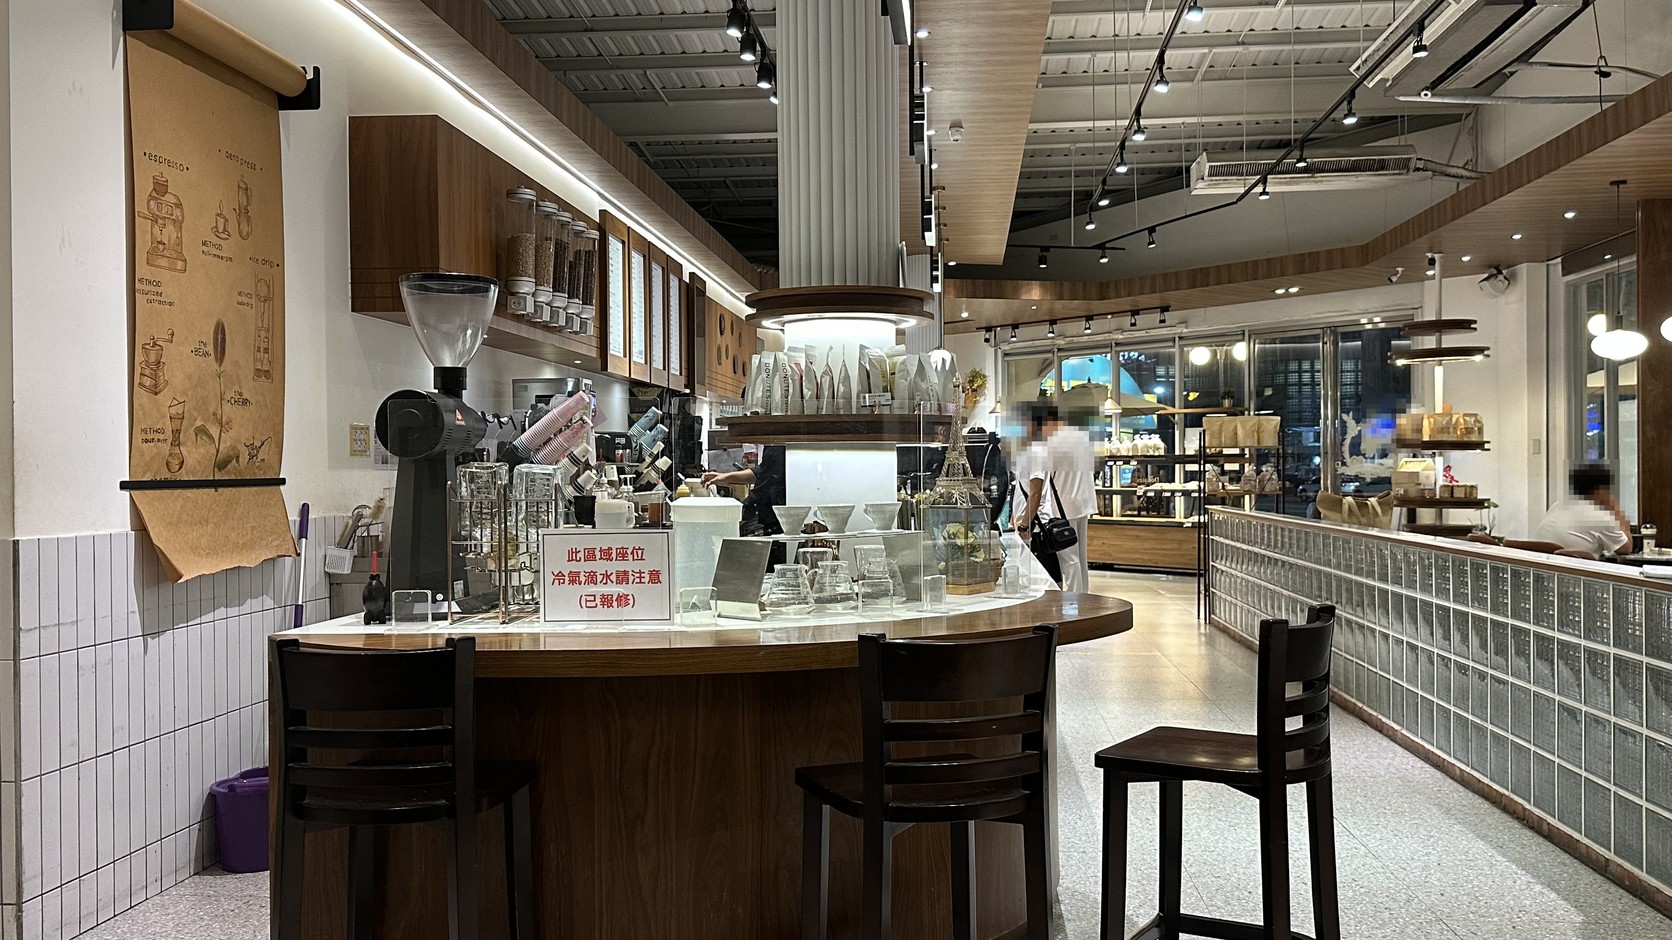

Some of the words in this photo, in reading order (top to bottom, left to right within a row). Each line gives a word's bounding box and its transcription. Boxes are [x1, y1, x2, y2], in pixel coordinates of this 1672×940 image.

[148, 152, 185, 172] espresso
[201, 239, 223, 251] METHOD
[194, 346, 209, 358] BEAN
[764, 362, 772, 399] DONUTES
[781, 362, 790, 399] DONUTES
[229, 396, 252, 407] CHERRY
[567, 546, 646, 562] 此區域座位
[551, 569, 662, 586] 冷氣滴水請注意
[578, 593, 636, 609] (已報修)
